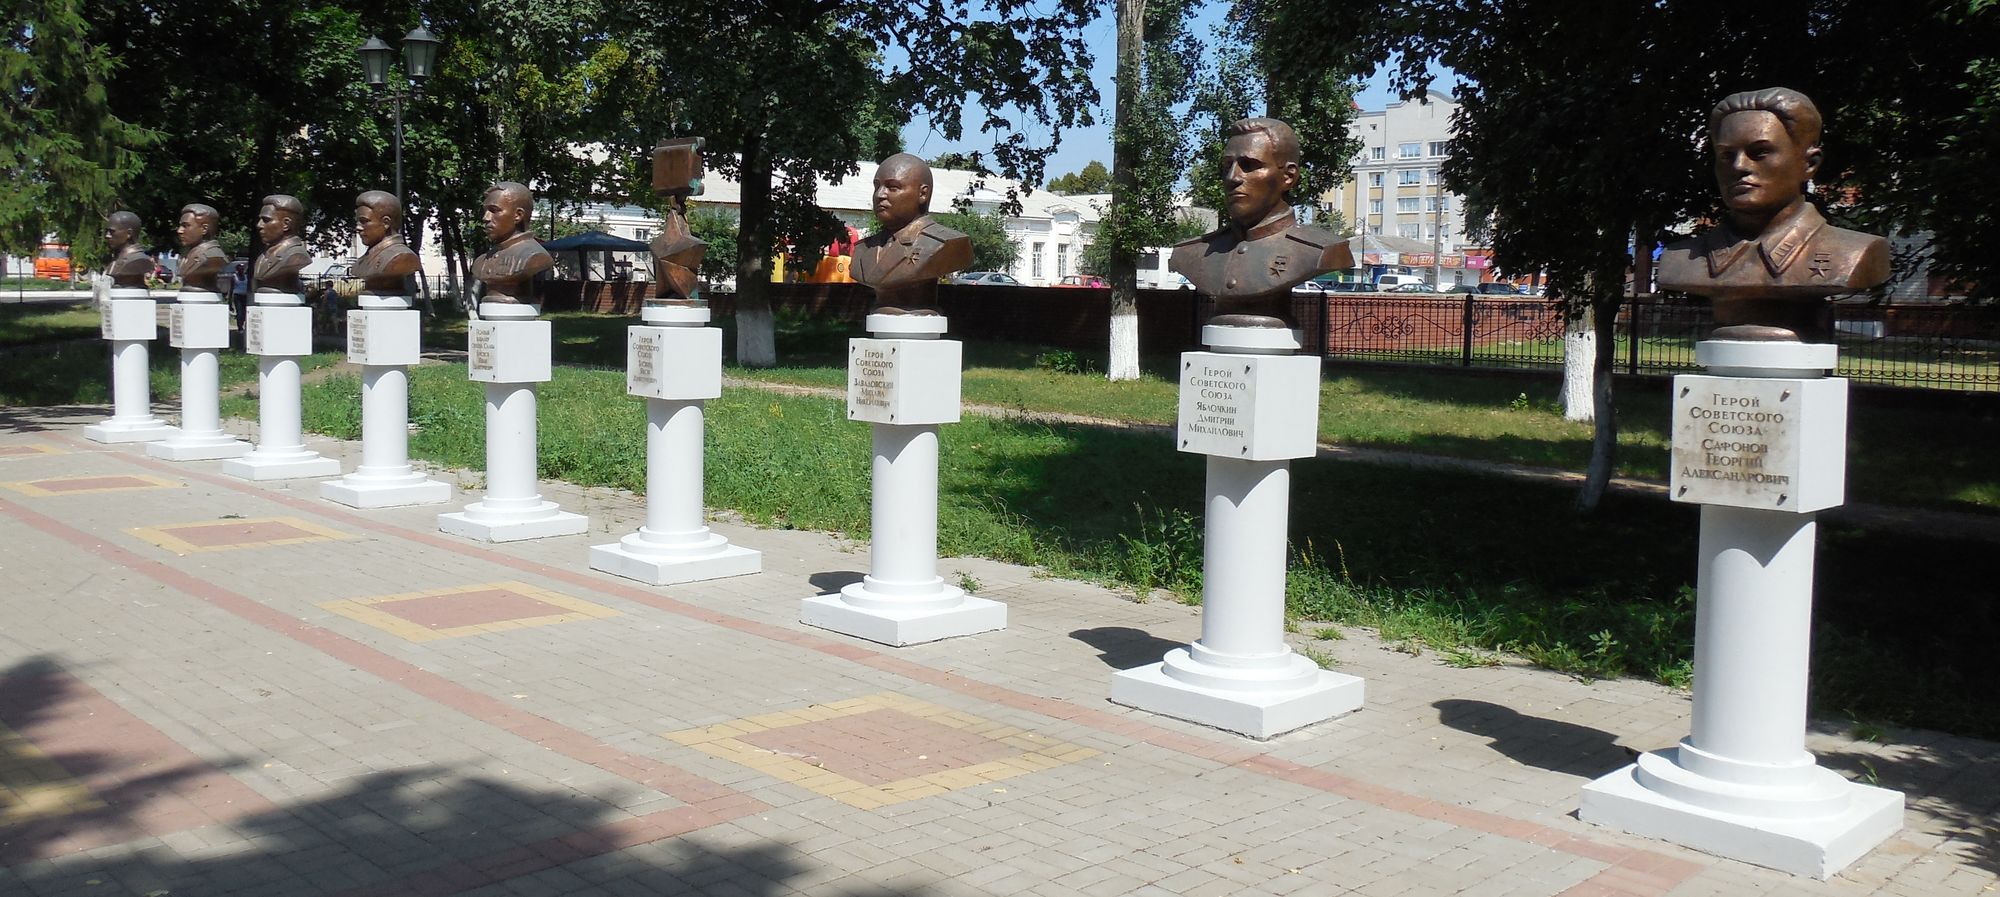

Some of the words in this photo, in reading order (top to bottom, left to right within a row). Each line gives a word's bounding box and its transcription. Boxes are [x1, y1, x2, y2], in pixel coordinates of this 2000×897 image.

[862, 367, 885, 377] СОЮЗА
[1203, 366, 1232, 378] ГЕРОЙ
[1190, 376, 1246, 391] СОВЕТСКОГО
[1200, 388, 1233, 401] СОЮЗА
[1712, 393, 1760, 408] ГЕРОЙ
[1196, 401, 1237, 414] ЯБЛОЧКИН
[1689, 406, 1784, 423] СОВЕТСКОГО
[1707, 421, 1763, 436] СОЮЗА
[1701, 438, 1768, 453] САФОНОВ
[1705, 452, 1763, 468] ГЕОРГИЙ
[1681, 466, 1789, 485] АЛЕКСАНДРОВИЧ
